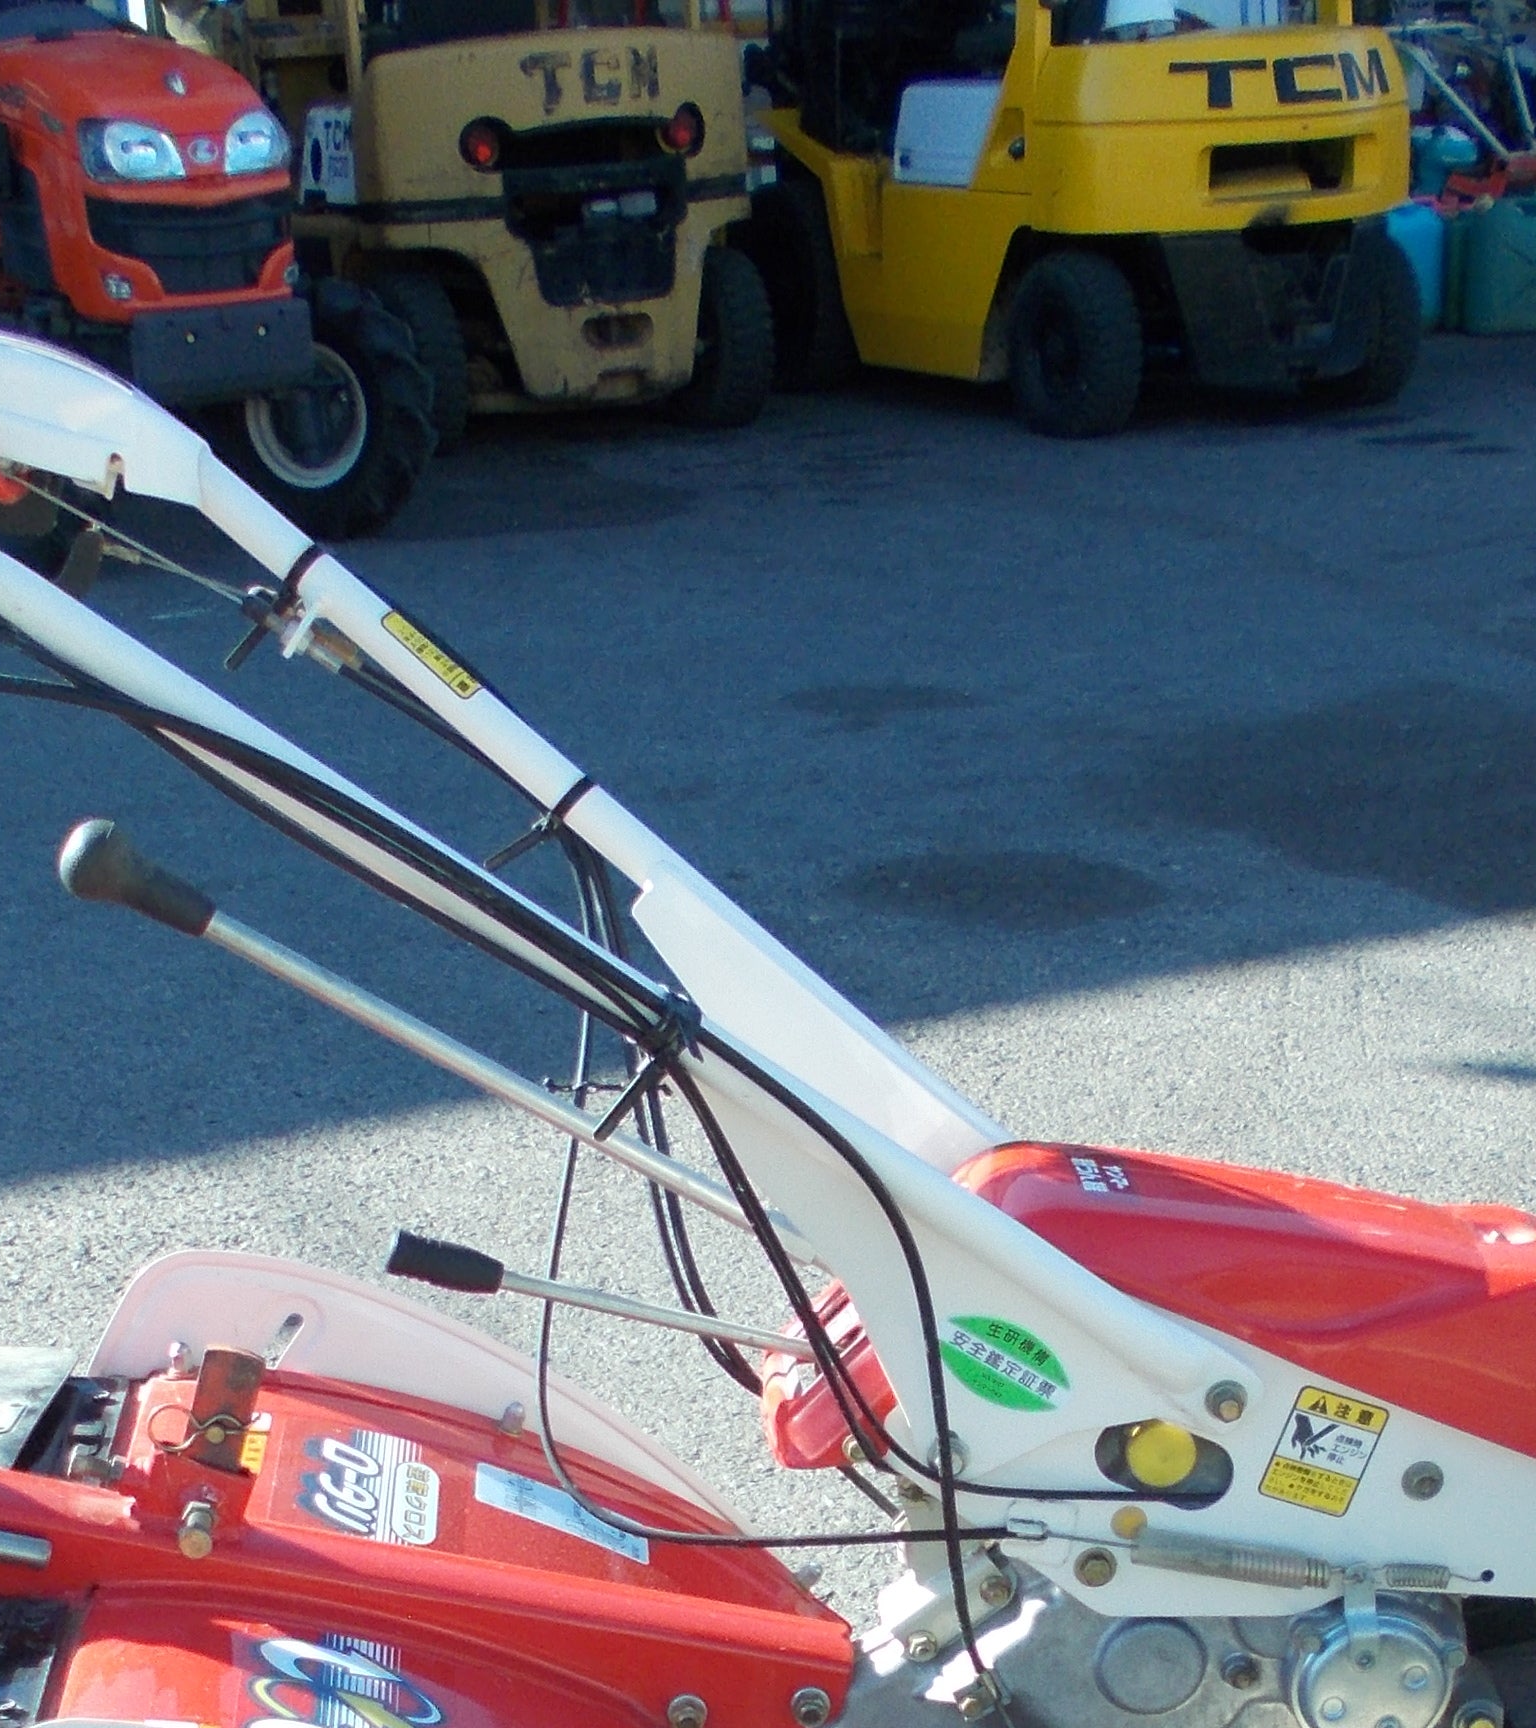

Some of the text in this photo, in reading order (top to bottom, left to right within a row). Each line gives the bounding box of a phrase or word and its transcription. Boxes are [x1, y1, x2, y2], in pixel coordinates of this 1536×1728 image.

[1168, 48, 1389, 108] TCM
[1334, 1402, 1375, 1427] 注意
[1331, 1444, 1368, 1460] エンジン
